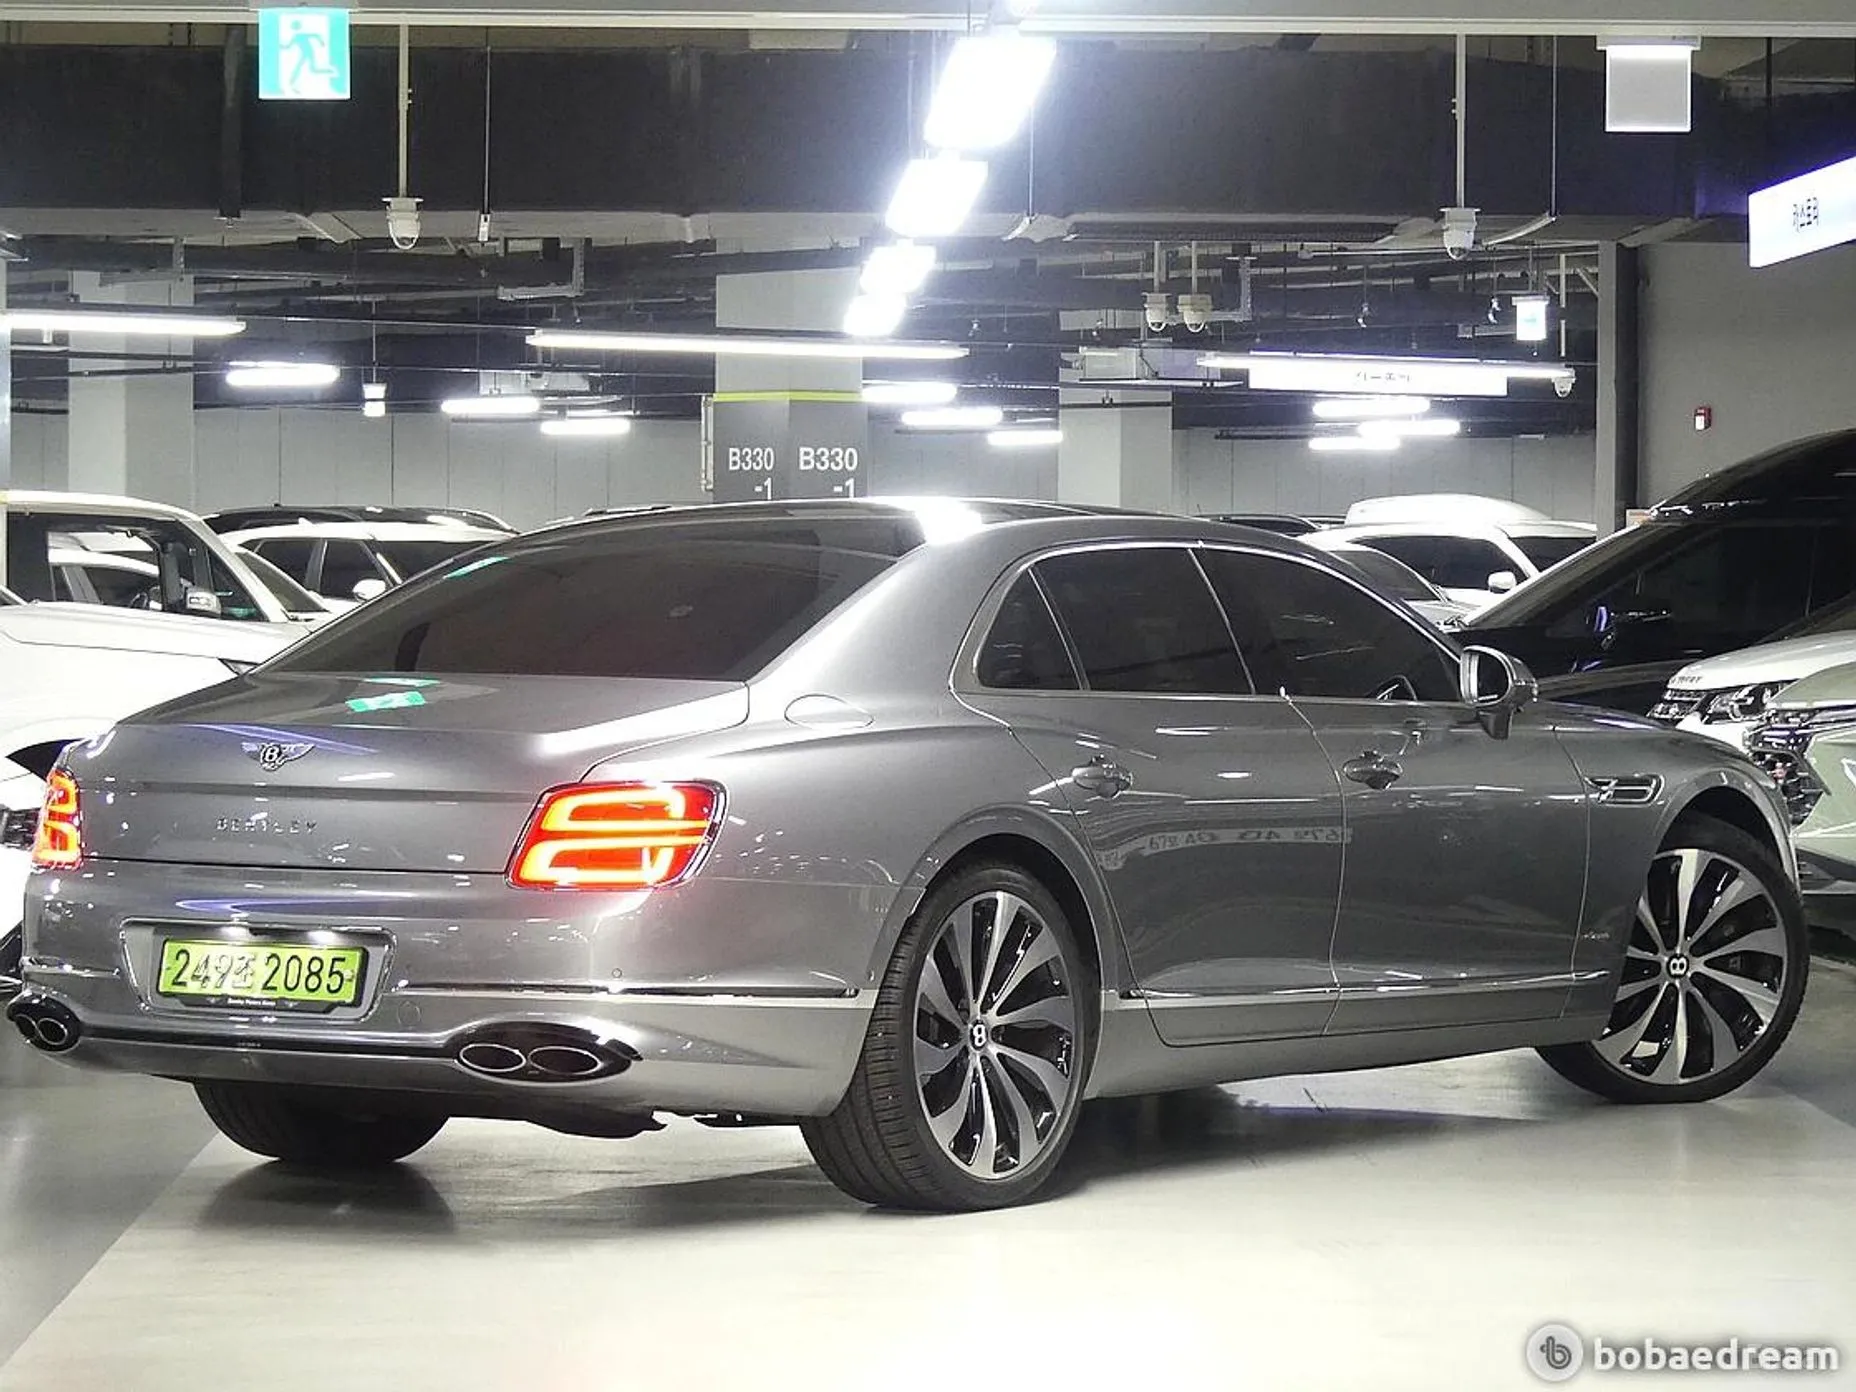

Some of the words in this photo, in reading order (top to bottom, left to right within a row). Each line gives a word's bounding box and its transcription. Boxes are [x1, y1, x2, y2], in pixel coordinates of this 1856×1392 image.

[729, 447, 775, 471] B330
[799, 447, 859, 471] B330
[754, 477, 773, 500] -1
[833, 478, 855, 499] -1
[261, 953, 346, 994] 2085
